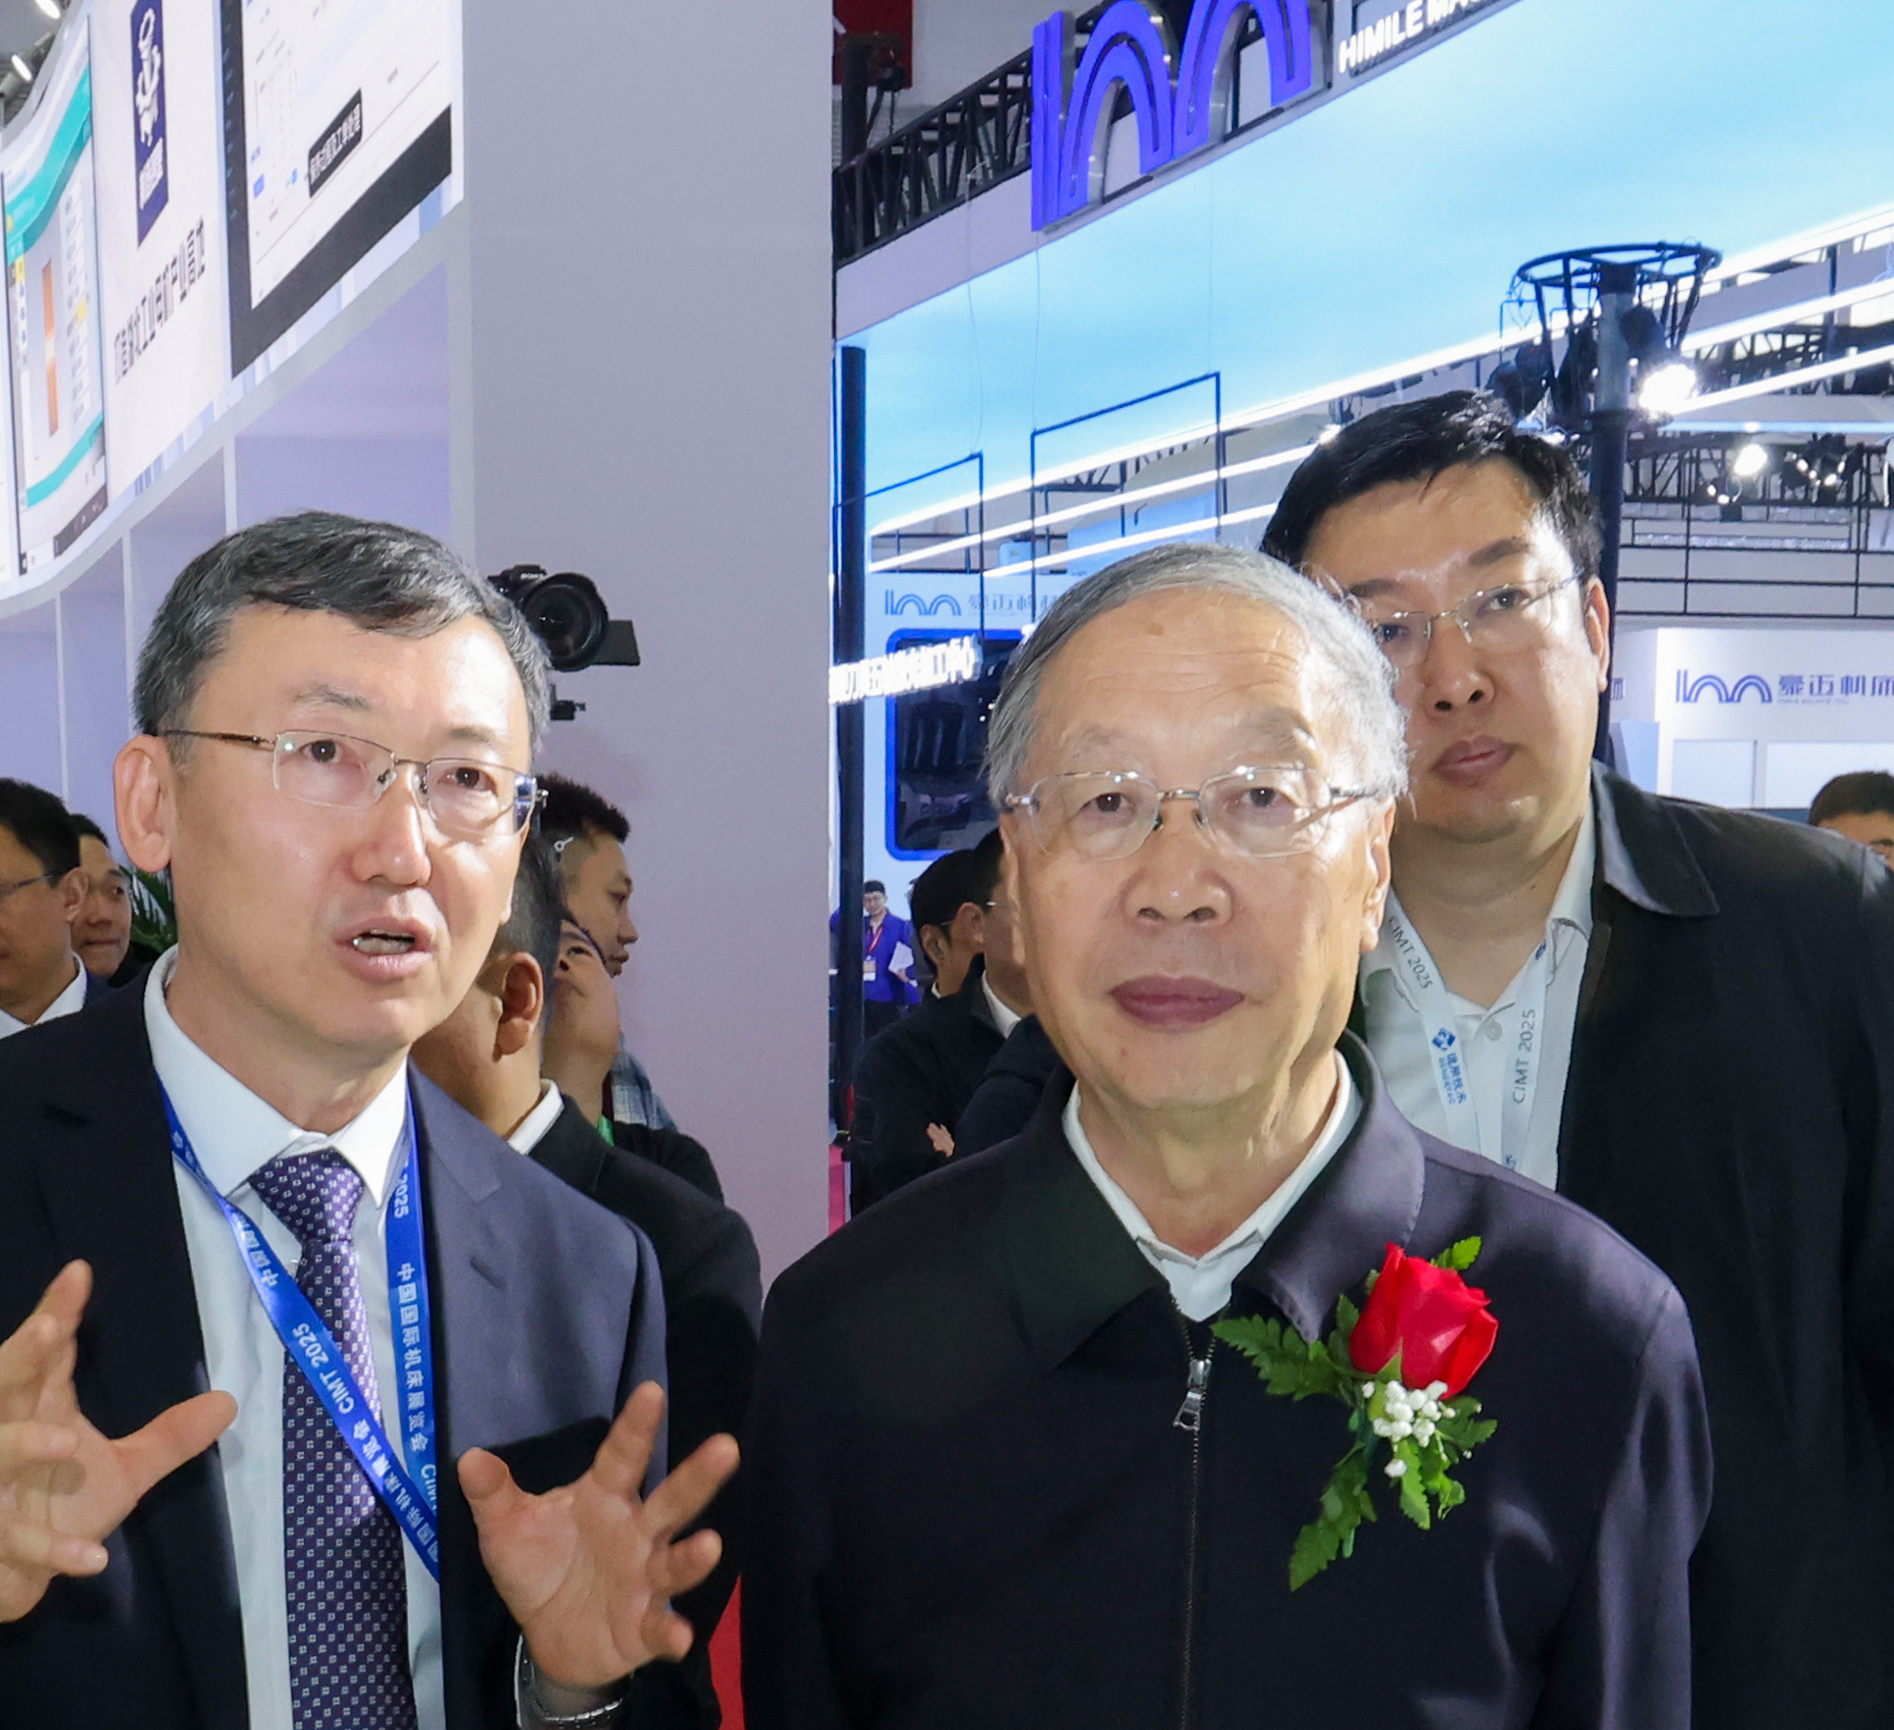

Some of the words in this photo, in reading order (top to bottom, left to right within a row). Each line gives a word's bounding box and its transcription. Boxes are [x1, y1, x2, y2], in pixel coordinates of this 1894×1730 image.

[1339, 3, 1424, 74] HIMILE
[1407, 956, 1434, 990] 2025
[1517, 1009, 1537, 1052] 2025
[1512, 1056, 1531, 1104] CIMT
[292, 1322, 330, 1369] 2025
[396, 1262, 429, 1453] 中国国际机床展览会
[319, 1369, 355, 1414] CIMT
